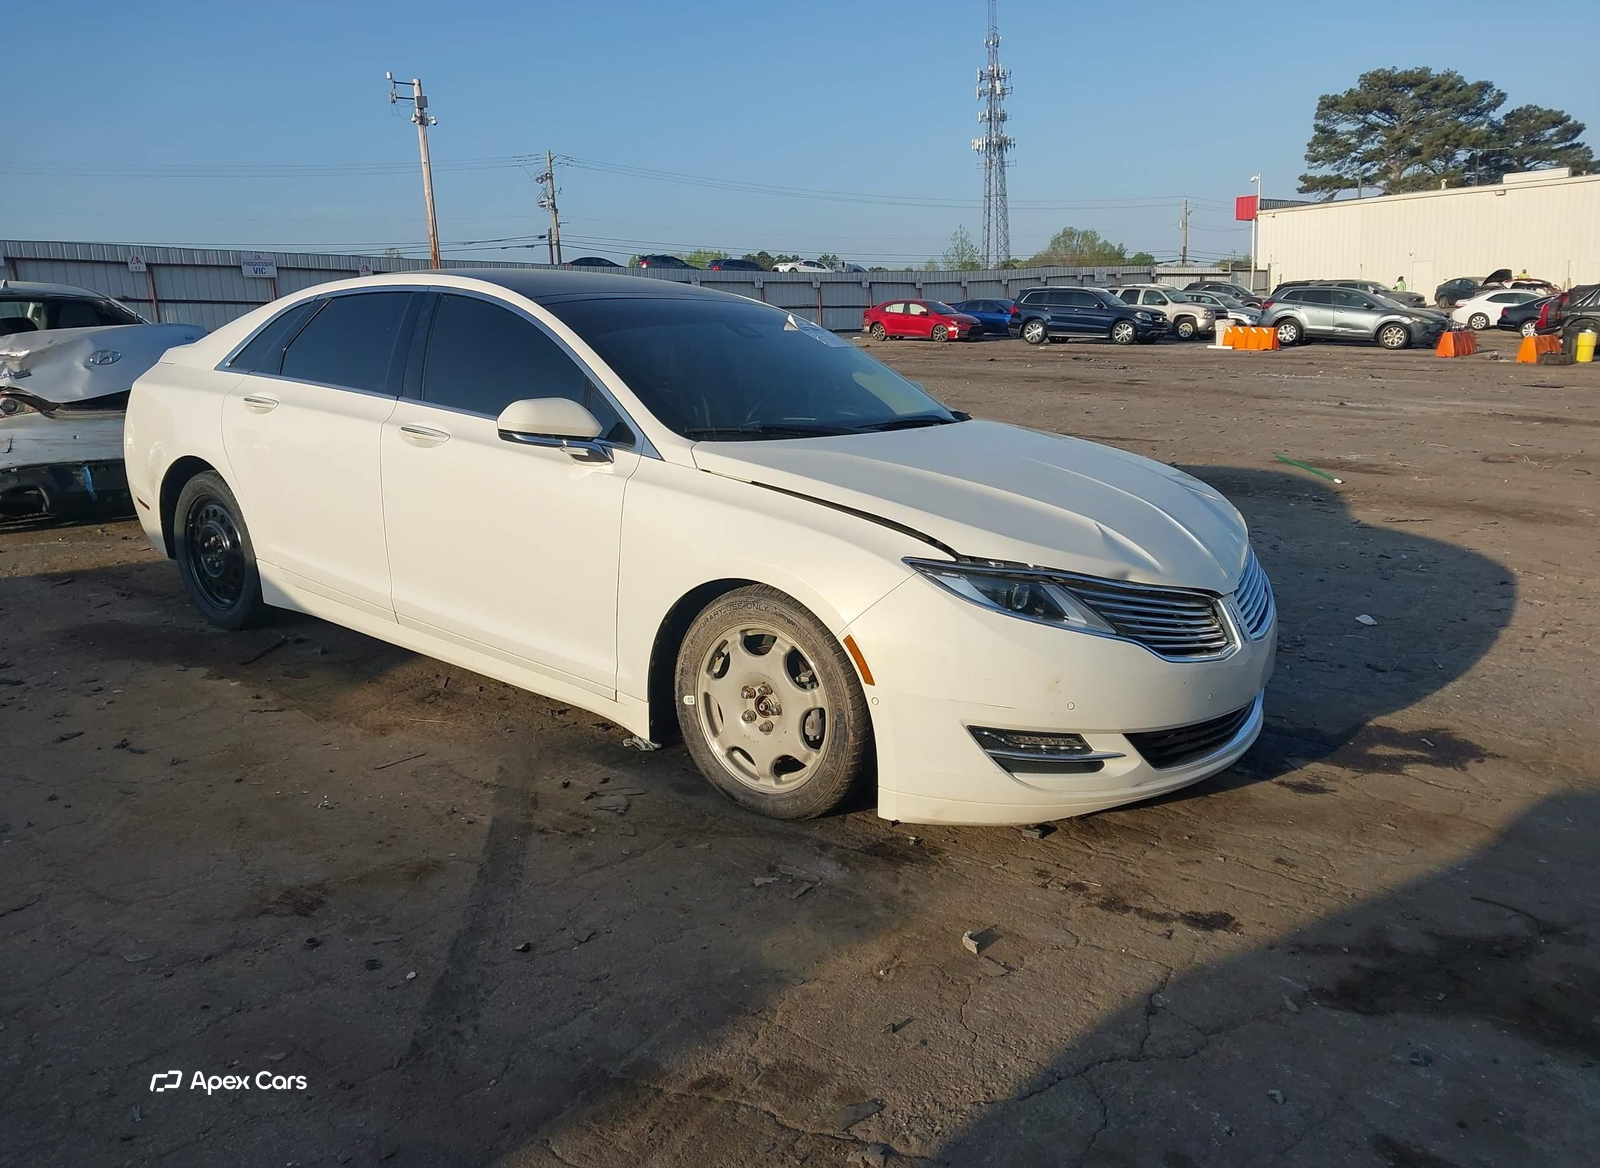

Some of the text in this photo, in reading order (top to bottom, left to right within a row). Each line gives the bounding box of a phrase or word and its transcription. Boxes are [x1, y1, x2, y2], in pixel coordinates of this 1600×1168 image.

[242, 260, 275, 268] PROGRESSIVE
[252, 267, 267, 275] VIC
[726, 601, 744, 612] USE
[748, 602, 769, 612] ONLY
